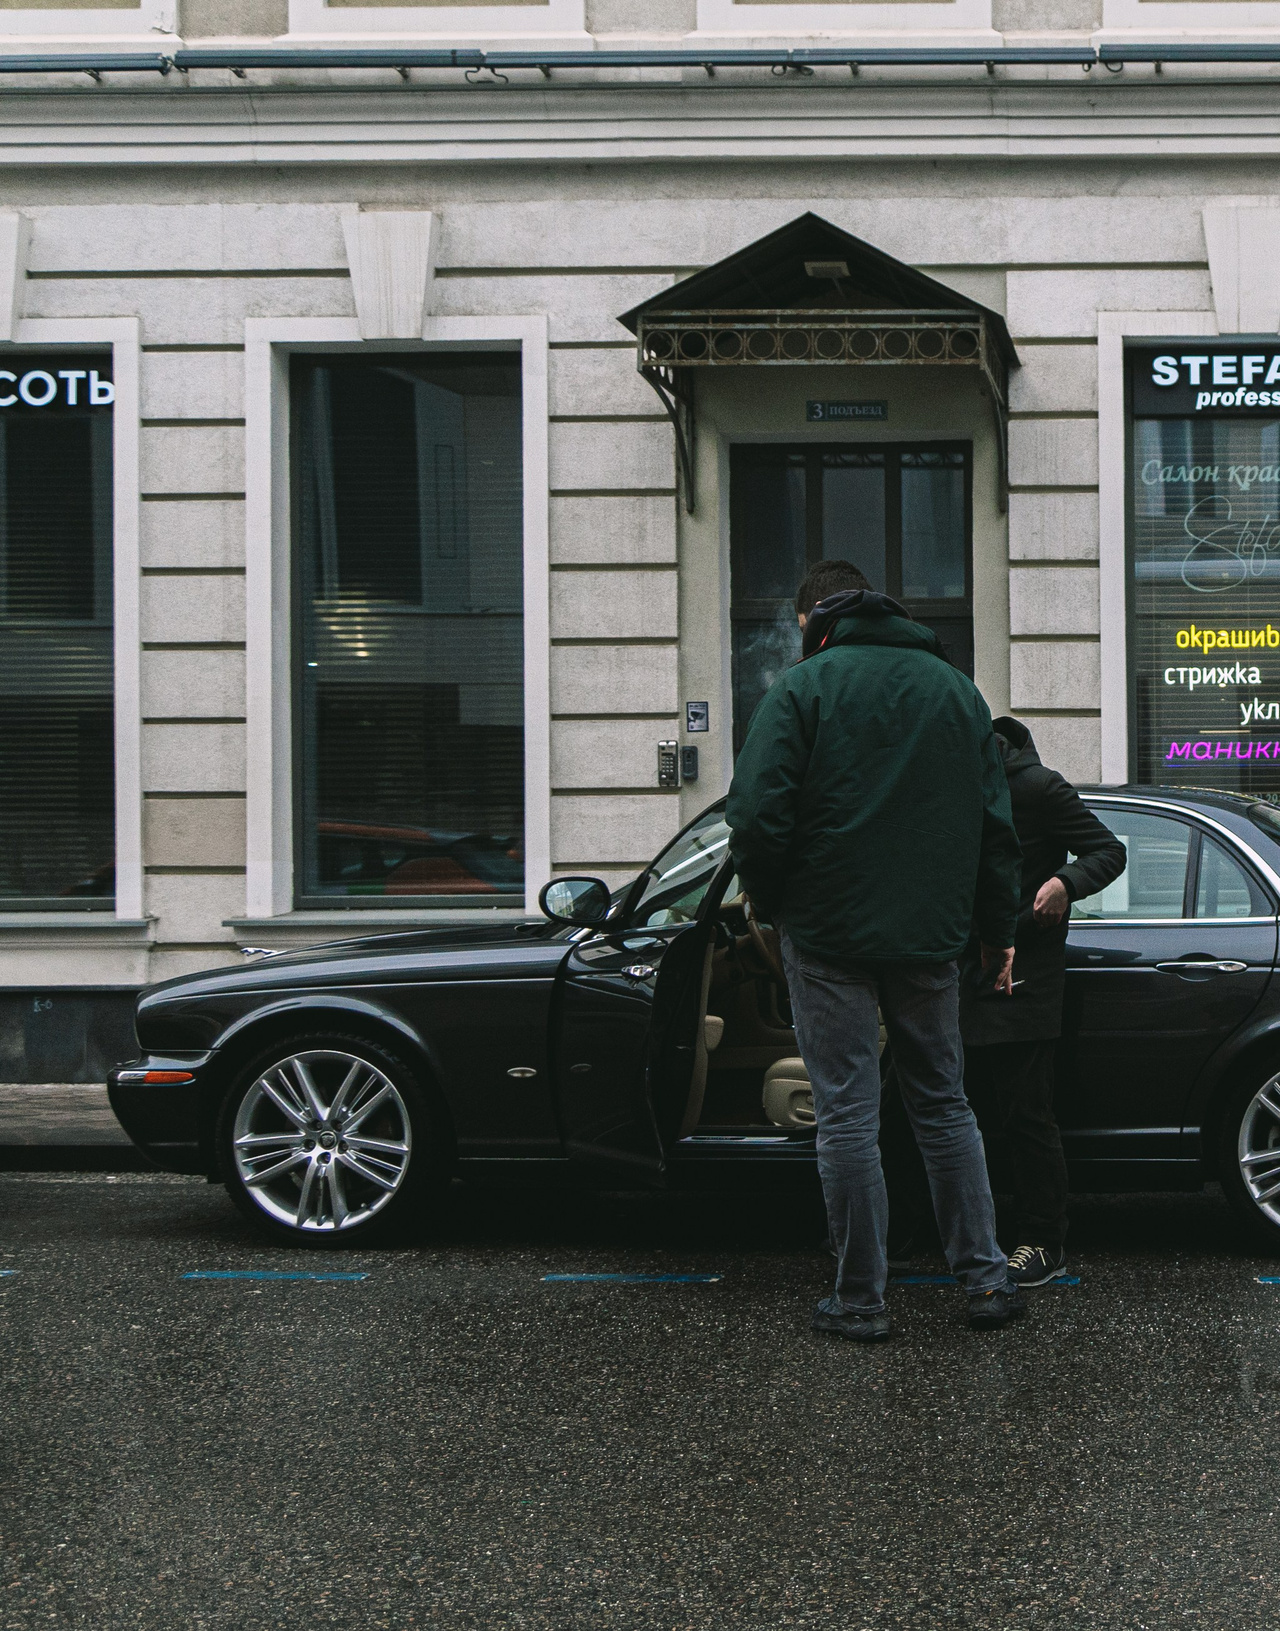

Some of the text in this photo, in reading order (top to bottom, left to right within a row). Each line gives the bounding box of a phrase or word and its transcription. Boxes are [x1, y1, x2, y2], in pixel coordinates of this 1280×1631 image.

[812, 404, 823, 419] 3
[1141, 459, 1220, 485] Салон
[1164, 661, 1262, 691] стрижка
